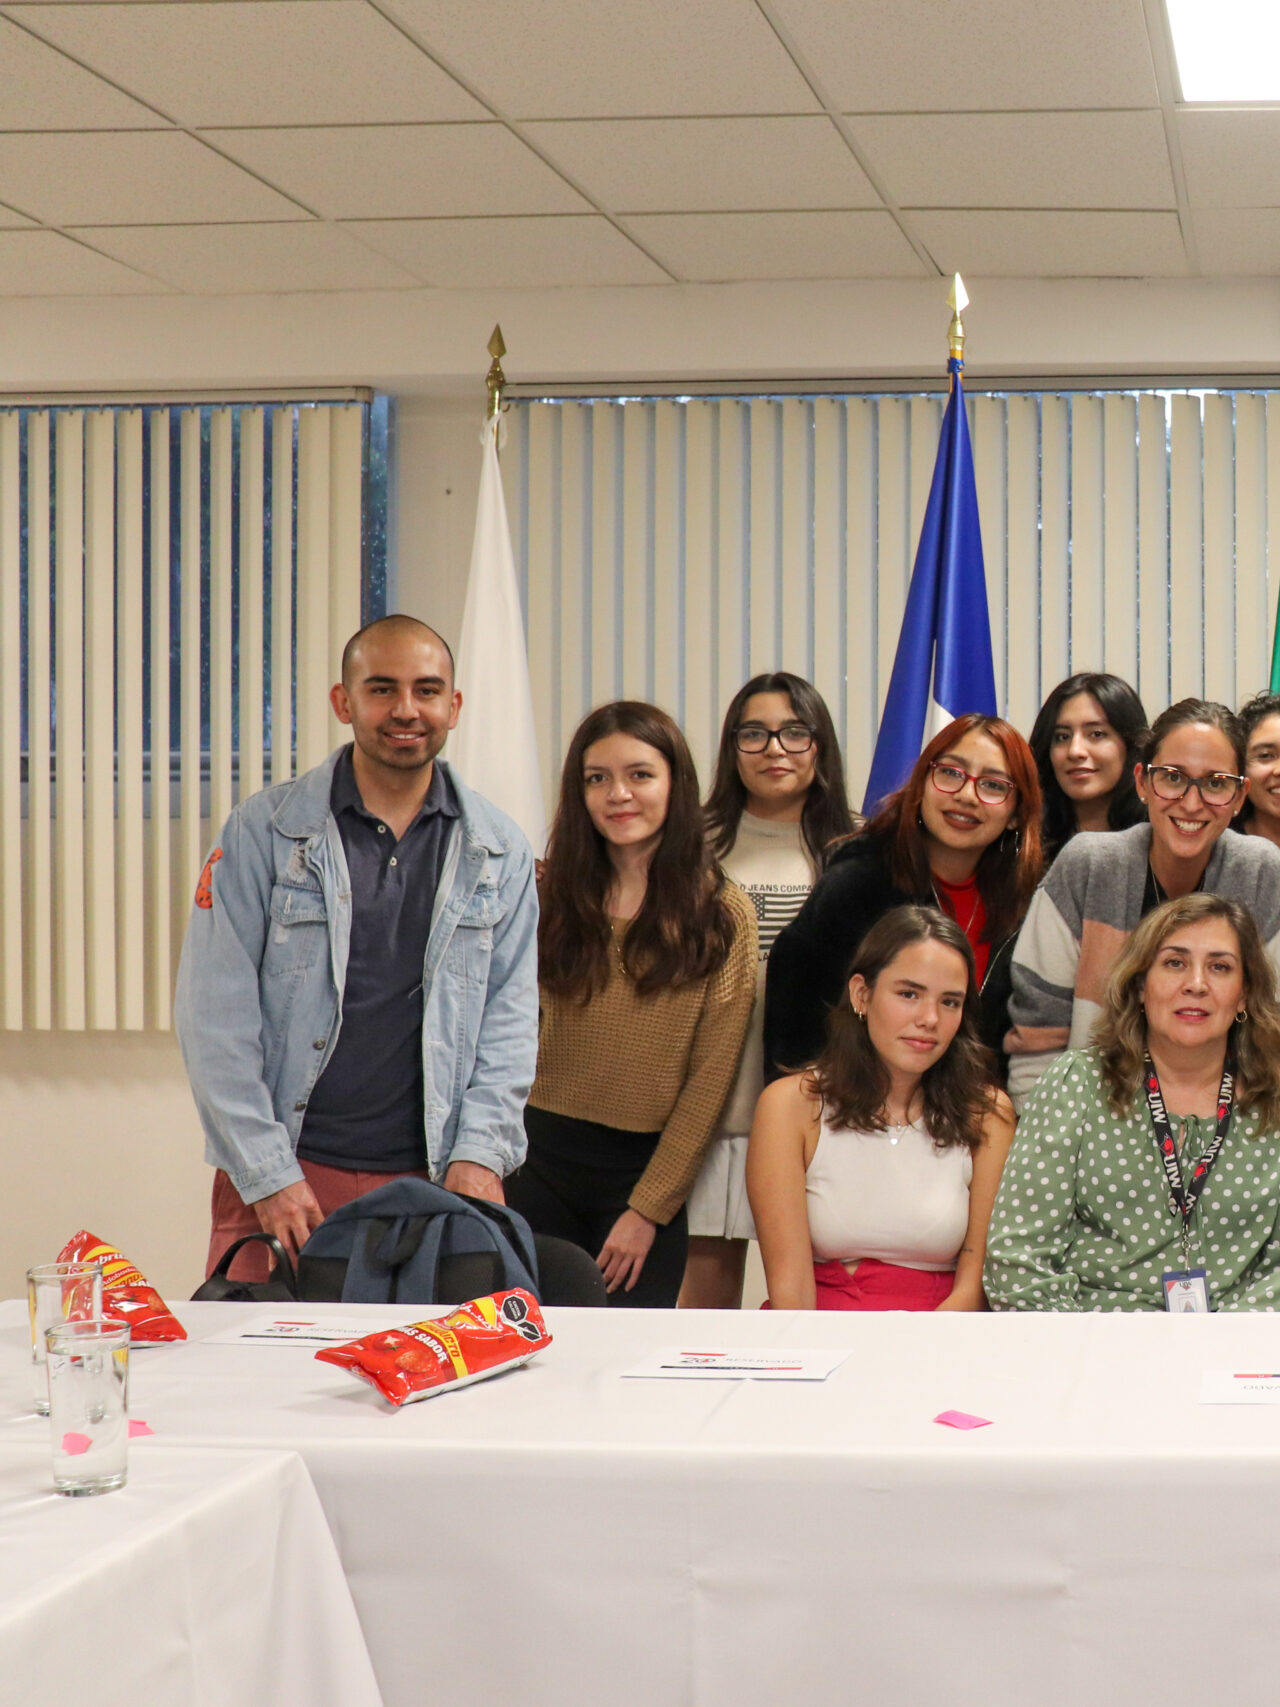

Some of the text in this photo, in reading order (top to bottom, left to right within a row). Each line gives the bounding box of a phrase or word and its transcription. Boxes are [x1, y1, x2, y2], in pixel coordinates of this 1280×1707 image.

[748, 883, 779, 893] JEANS
[780, 884, 813, 893] COMPA
[1218, 1072, 1233, 1104] UIW
[1148, 1092, 1167, 1124] UIW
[1201, 1136, 1223, 1163] UIW
[1162, 1153, 1183, 1189] UIW
[414, 1332, 447, 1363] SABOR
